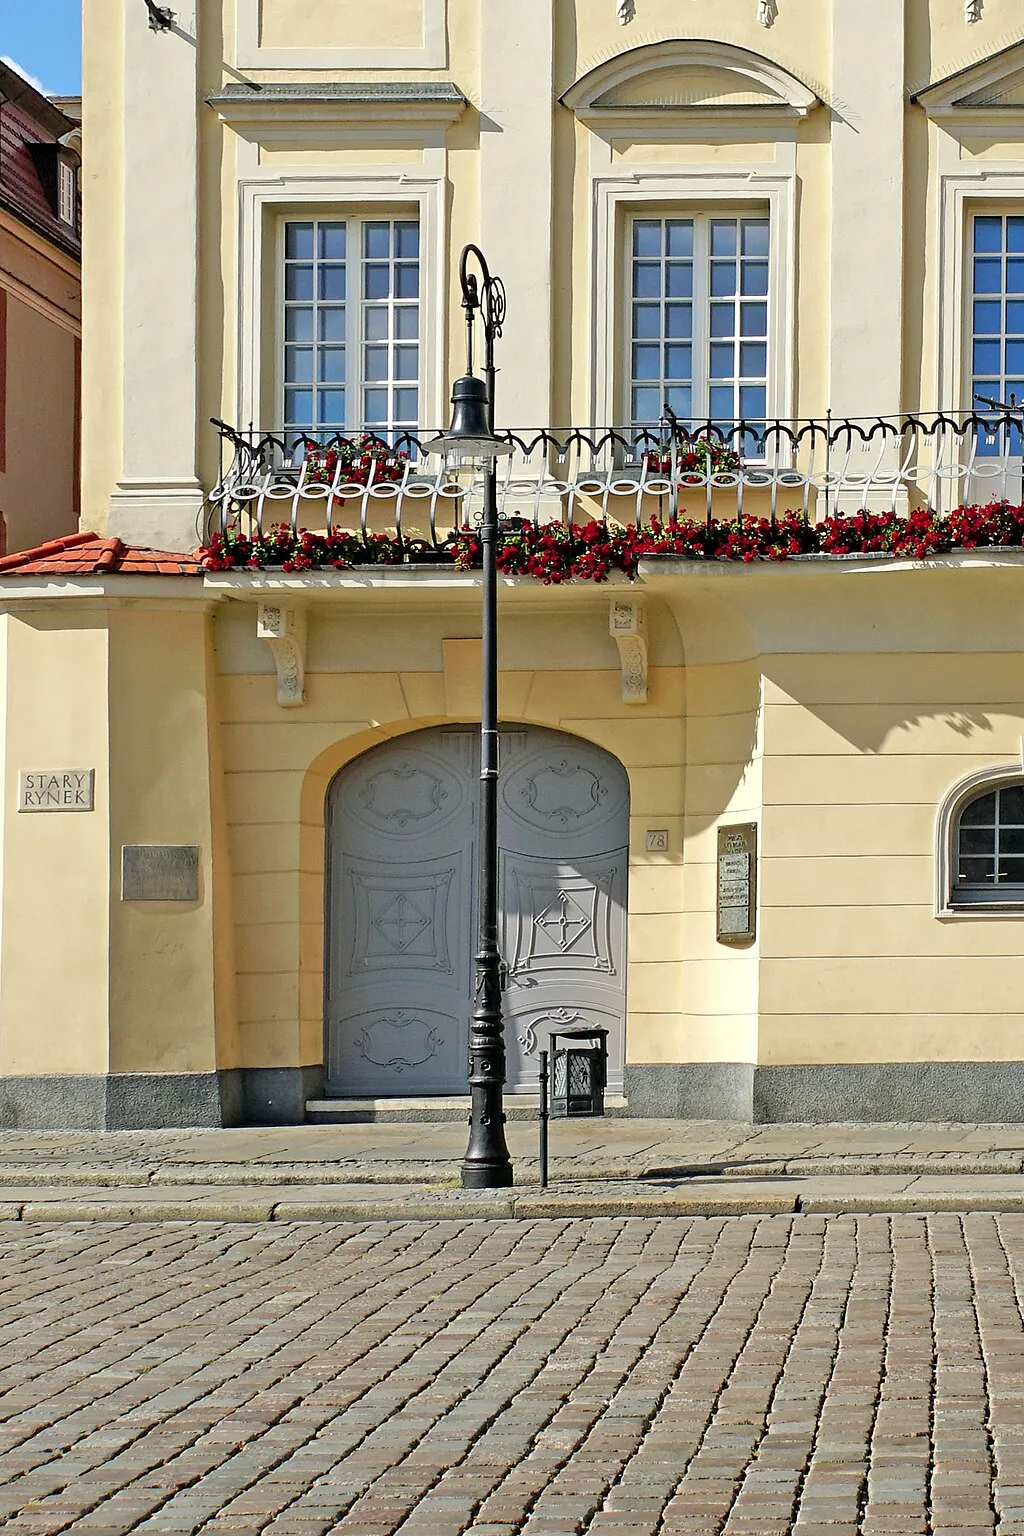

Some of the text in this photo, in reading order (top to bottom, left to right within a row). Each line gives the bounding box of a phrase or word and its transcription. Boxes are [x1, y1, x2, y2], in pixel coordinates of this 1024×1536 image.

[26, 774, 85, 789] STARY
[25, 790, 85, 805] RYNEK
[649, 834, 665, 848] 78
